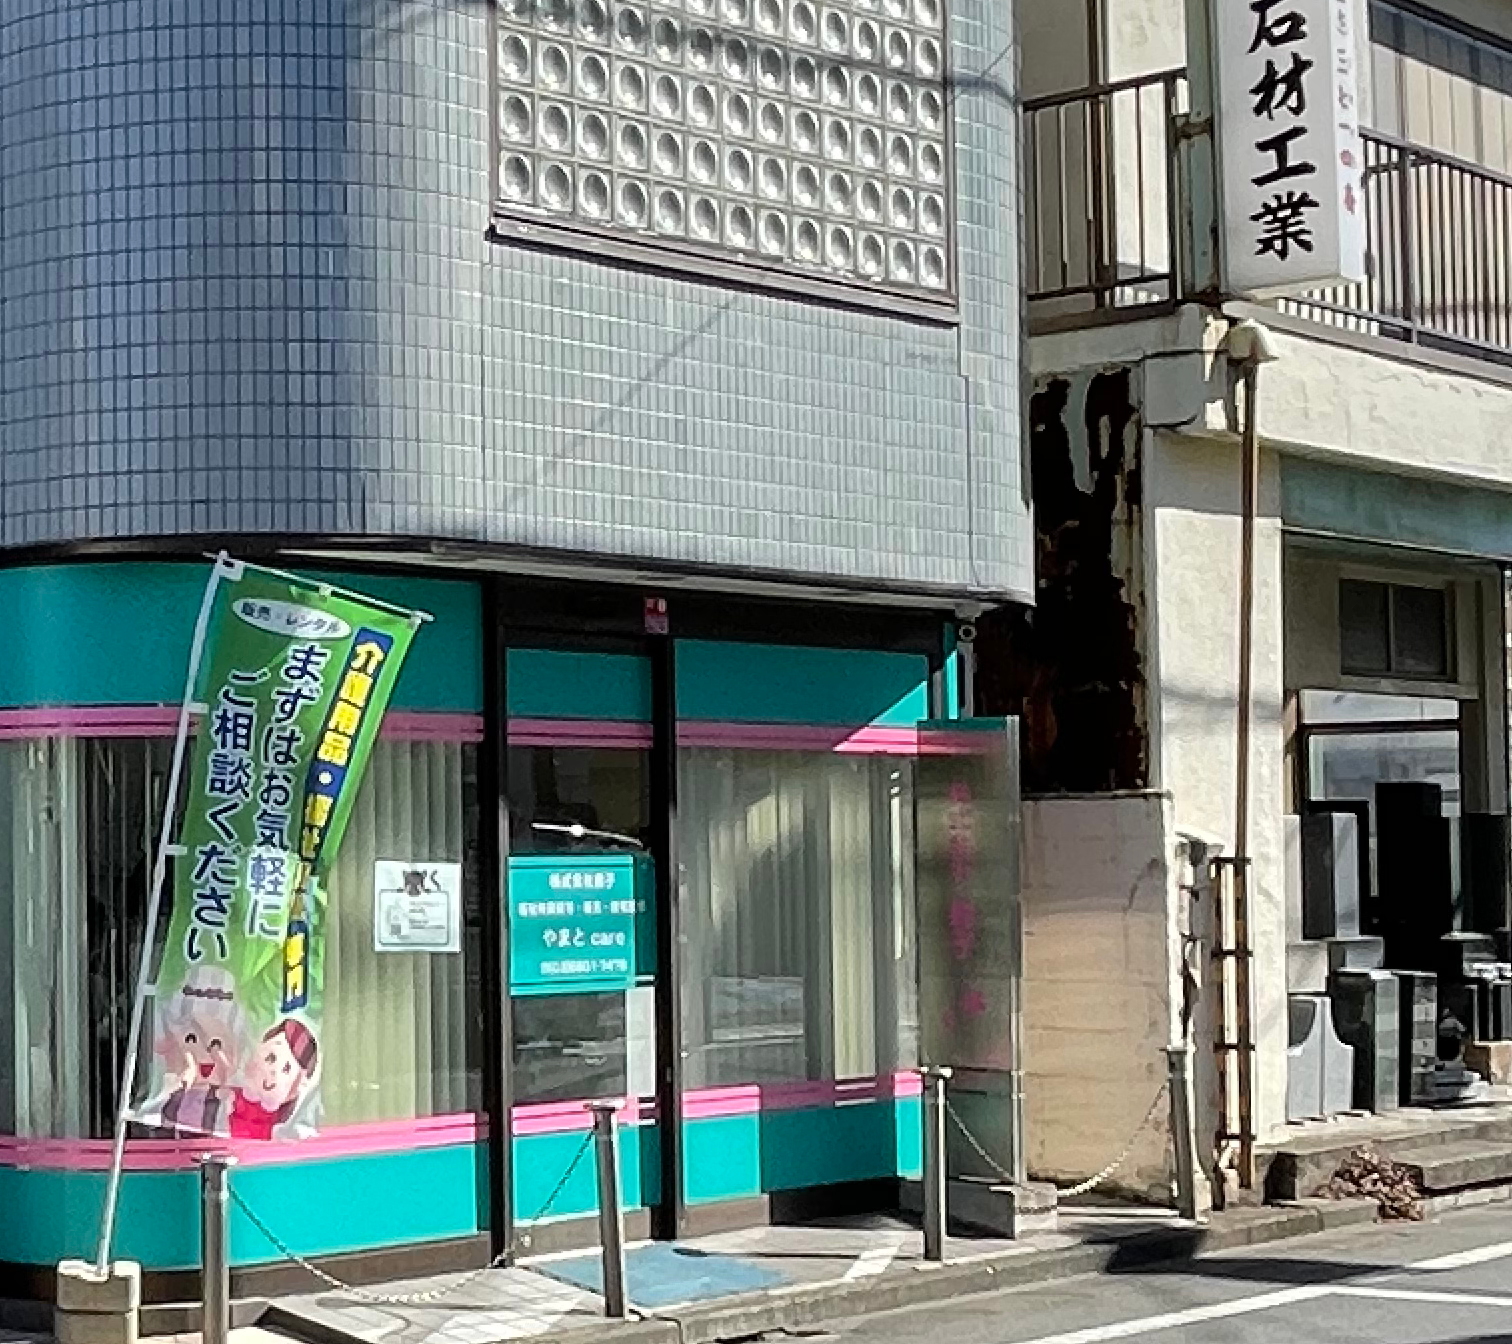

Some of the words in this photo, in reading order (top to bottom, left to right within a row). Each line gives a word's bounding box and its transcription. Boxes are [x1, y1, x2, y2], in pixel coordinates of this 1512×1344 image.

[187, 668, 264, 962] ご相談ください
[246, 643, 328, 939] まずはお気軽に
